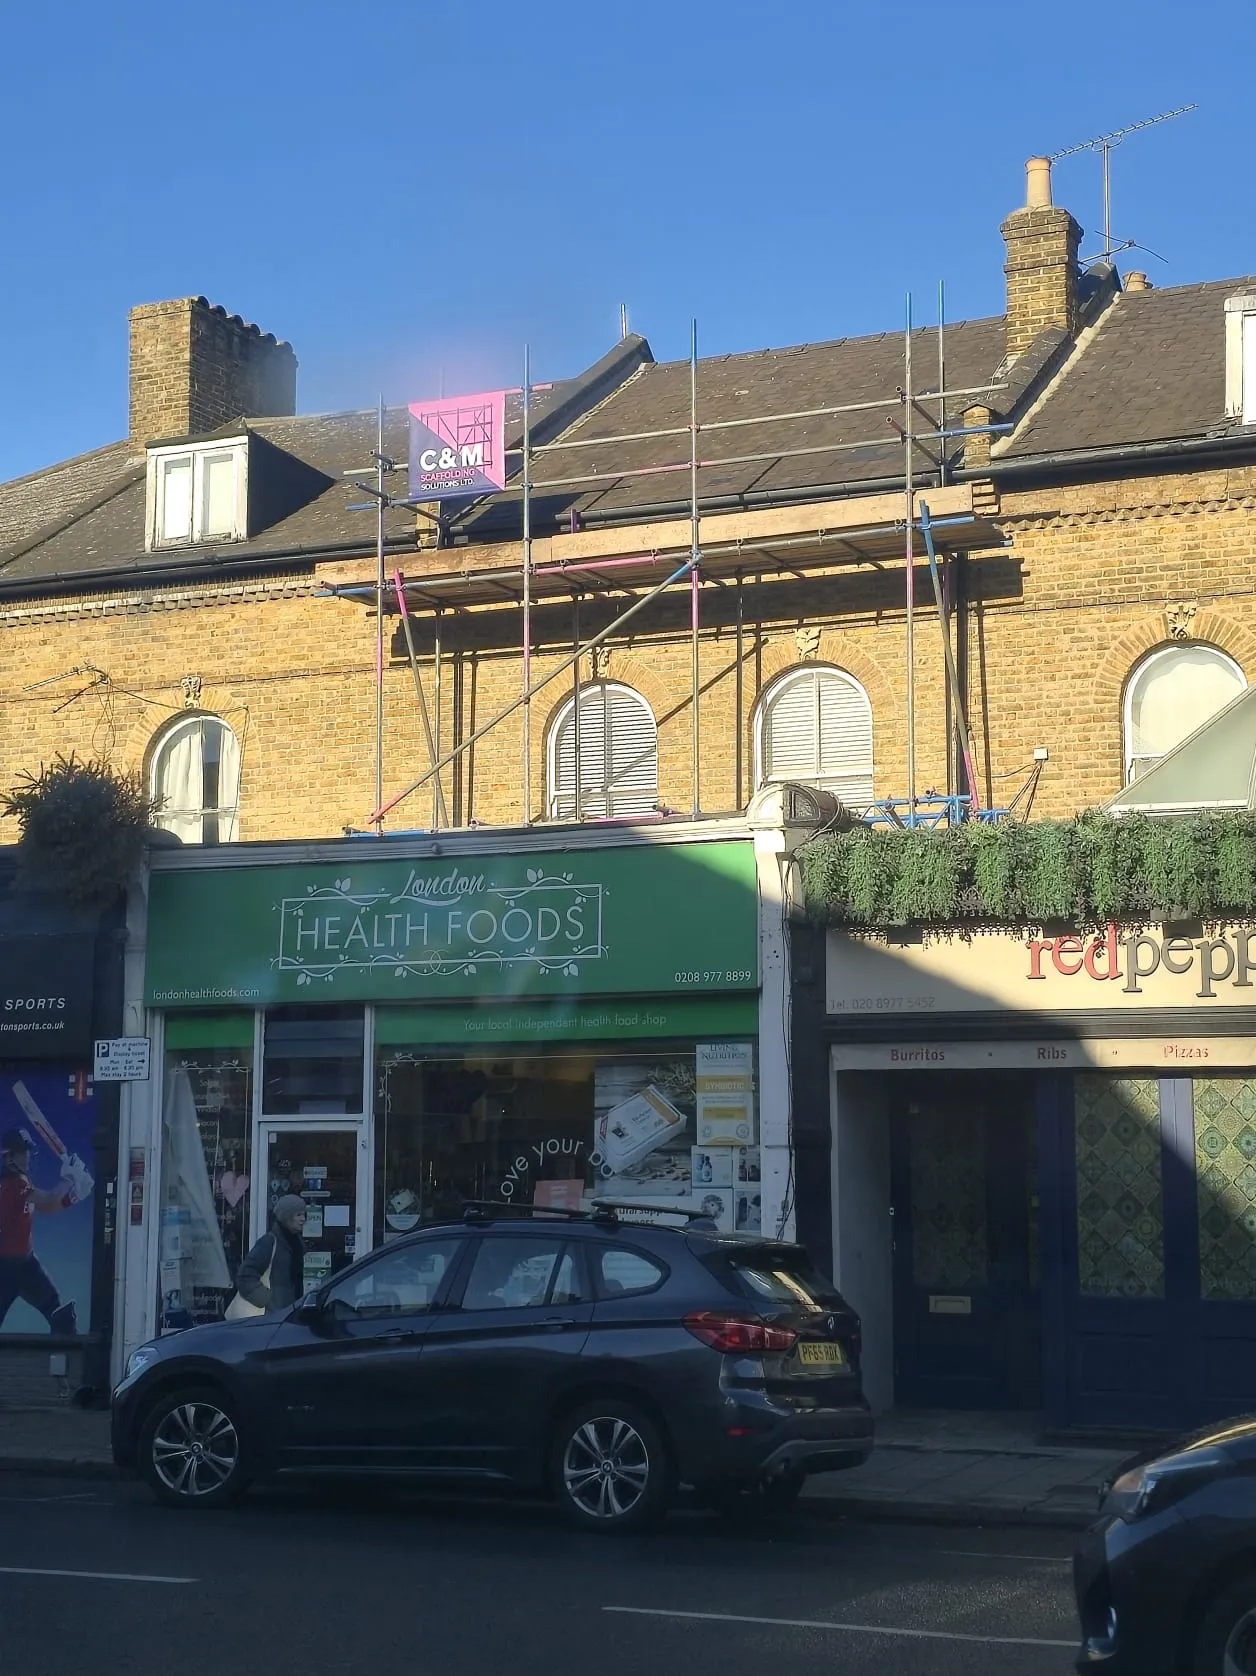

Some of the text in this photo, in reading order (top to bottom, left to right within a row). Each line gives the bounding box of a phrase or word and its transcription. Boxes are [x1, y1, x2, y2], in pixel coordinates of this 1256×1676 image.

[420, 468, 475, 482] SCAFFOLDING
[421, 479, 459, 491] SOLUTIONS
[392, 868, 486, 905] London
[297, 906, 584, 950] HEALTH FOODS
[674, 970, 751, 983] 0208 977 8899
[153, 987, 260, 1000] londonhealthfoods.com
[5, 998, 66, 1011] SPORTS
[463, 1012, 667, 1032] Your local independent health food shop
[890, 1048, 945, 1061] Burritos
[1037, 1047, 1067, 1060] Ribs
[1163, 1044, 1209, 1059] Pizzas
[500, 1155, 530, 1204] ove
[531, 1138, 584, 1167] your
